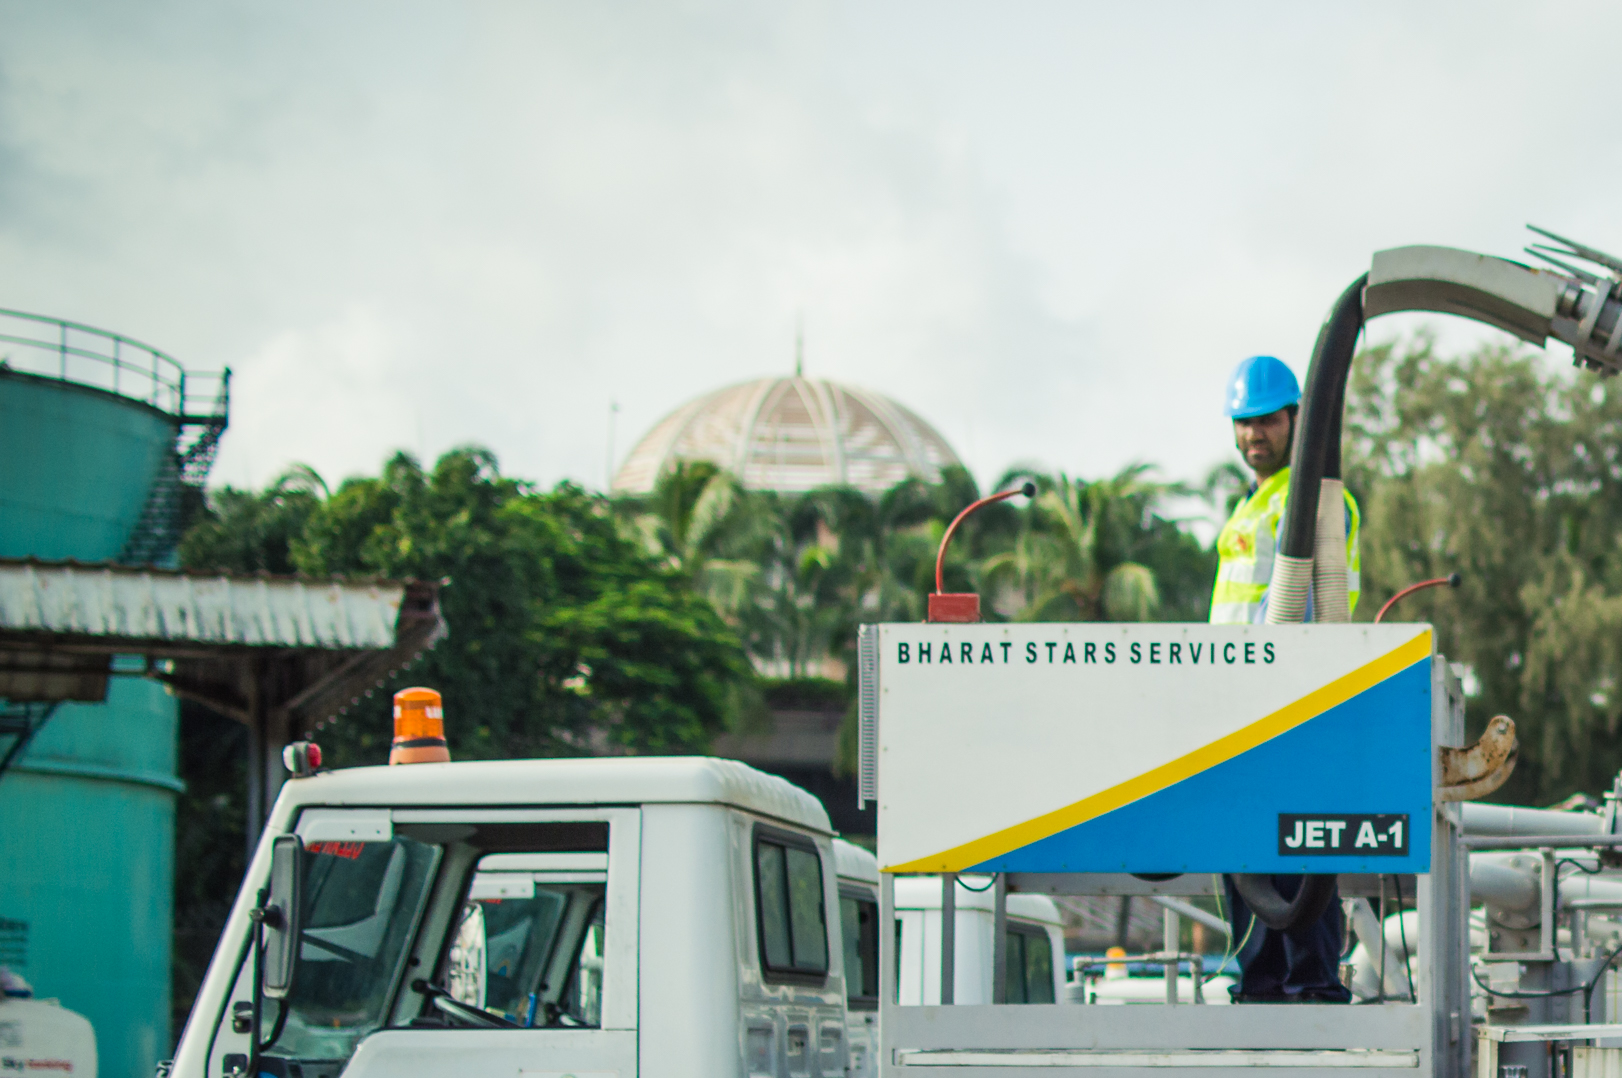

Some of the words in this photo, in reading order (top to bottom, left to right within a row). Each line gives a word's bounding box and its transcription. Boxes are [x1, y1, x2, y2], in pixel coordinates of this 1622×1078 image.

[898, 642, 1012, 664] BHARAT
[1025, 642, 1117, 664] STARS
[1129, 642, 1276, 664] SERVICES
[1284, 820, 1346, 848] JET
[1354, 820, 1403, 848] A-1
